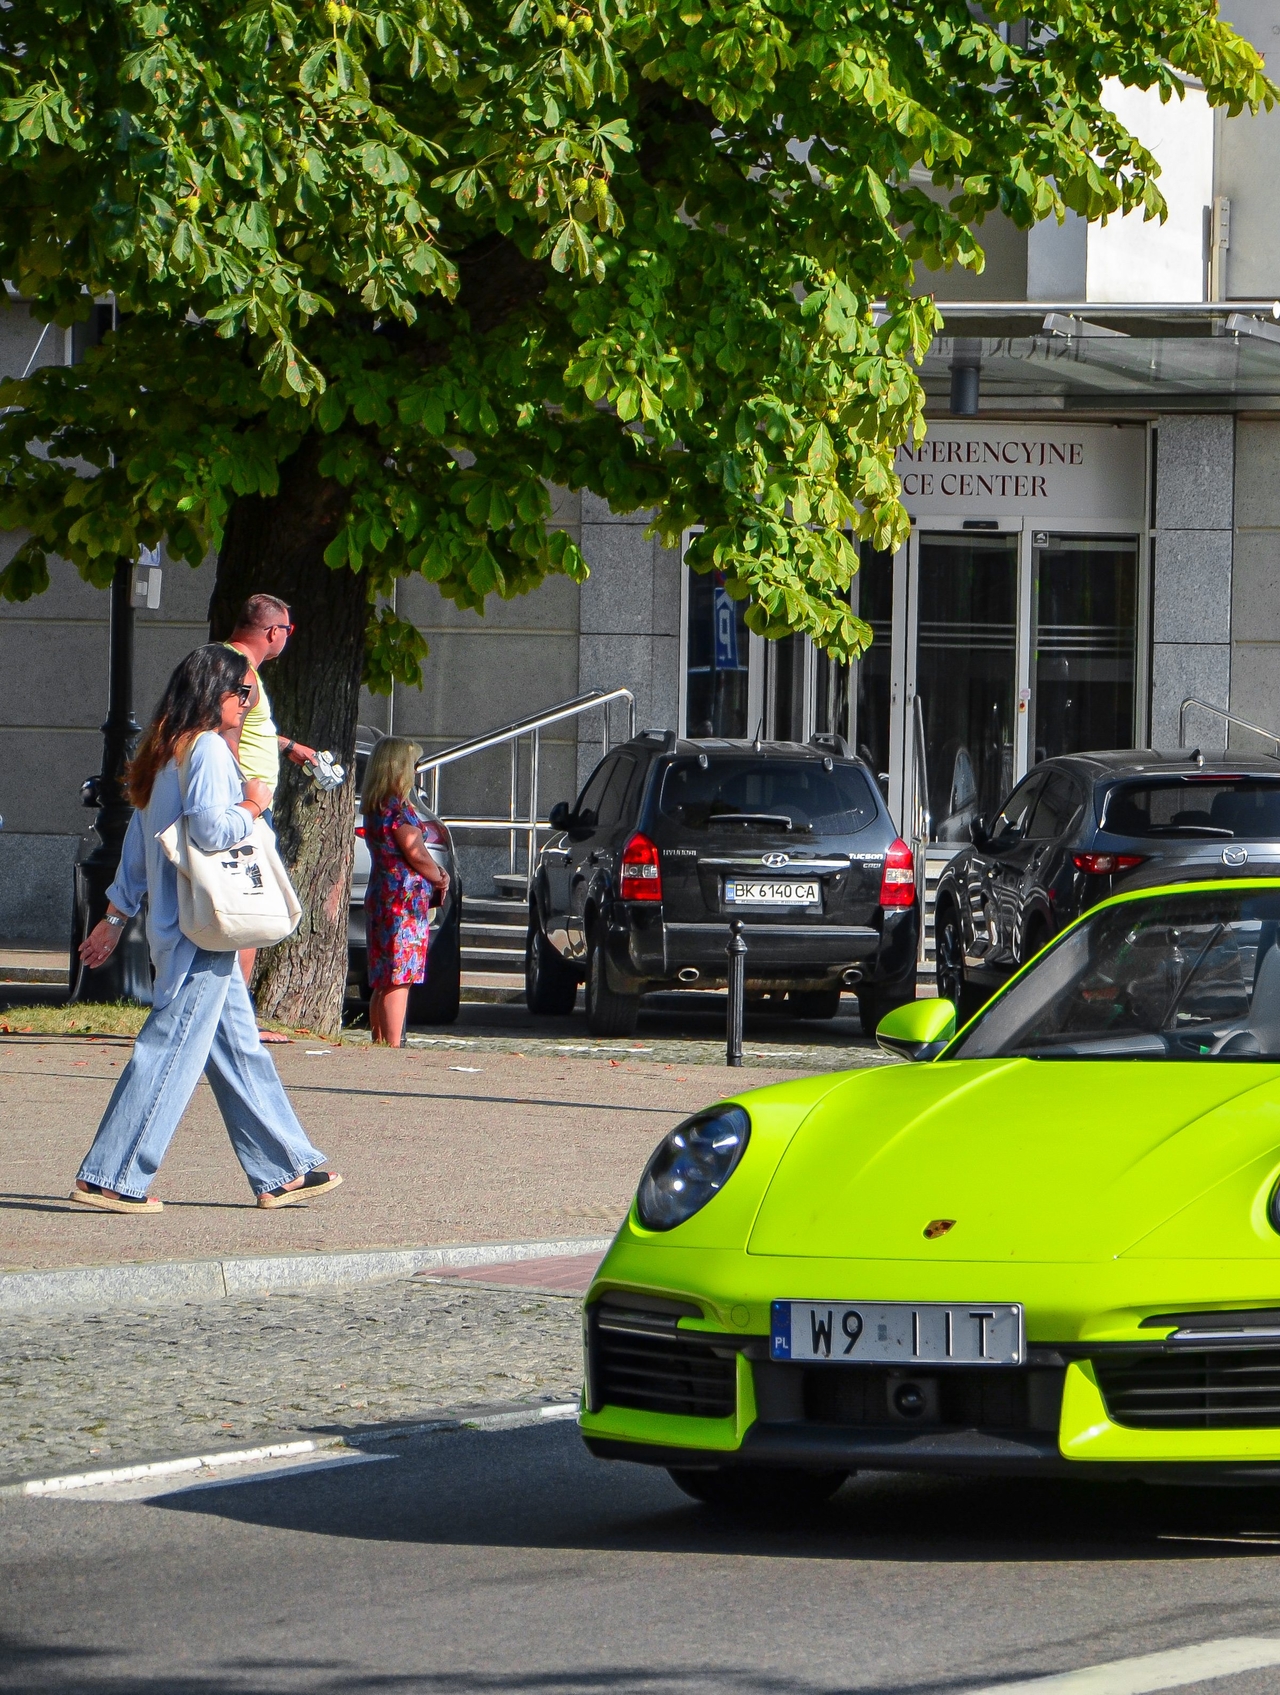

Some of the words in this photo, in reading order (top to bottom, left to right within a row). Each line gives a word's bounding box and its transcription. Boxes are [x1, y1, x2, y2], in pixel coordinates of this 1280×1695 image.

[898, 473, 934, 496] CE
[940, 473, 1048, 497] CENTER
[735, 883, 756, 898] BK
[759, 884, 792, 898] 6140
[795, 885, 816, 899] CA
[810, 1309, 863, 1355] W9
[775, 1336, 789, 1349] PL
